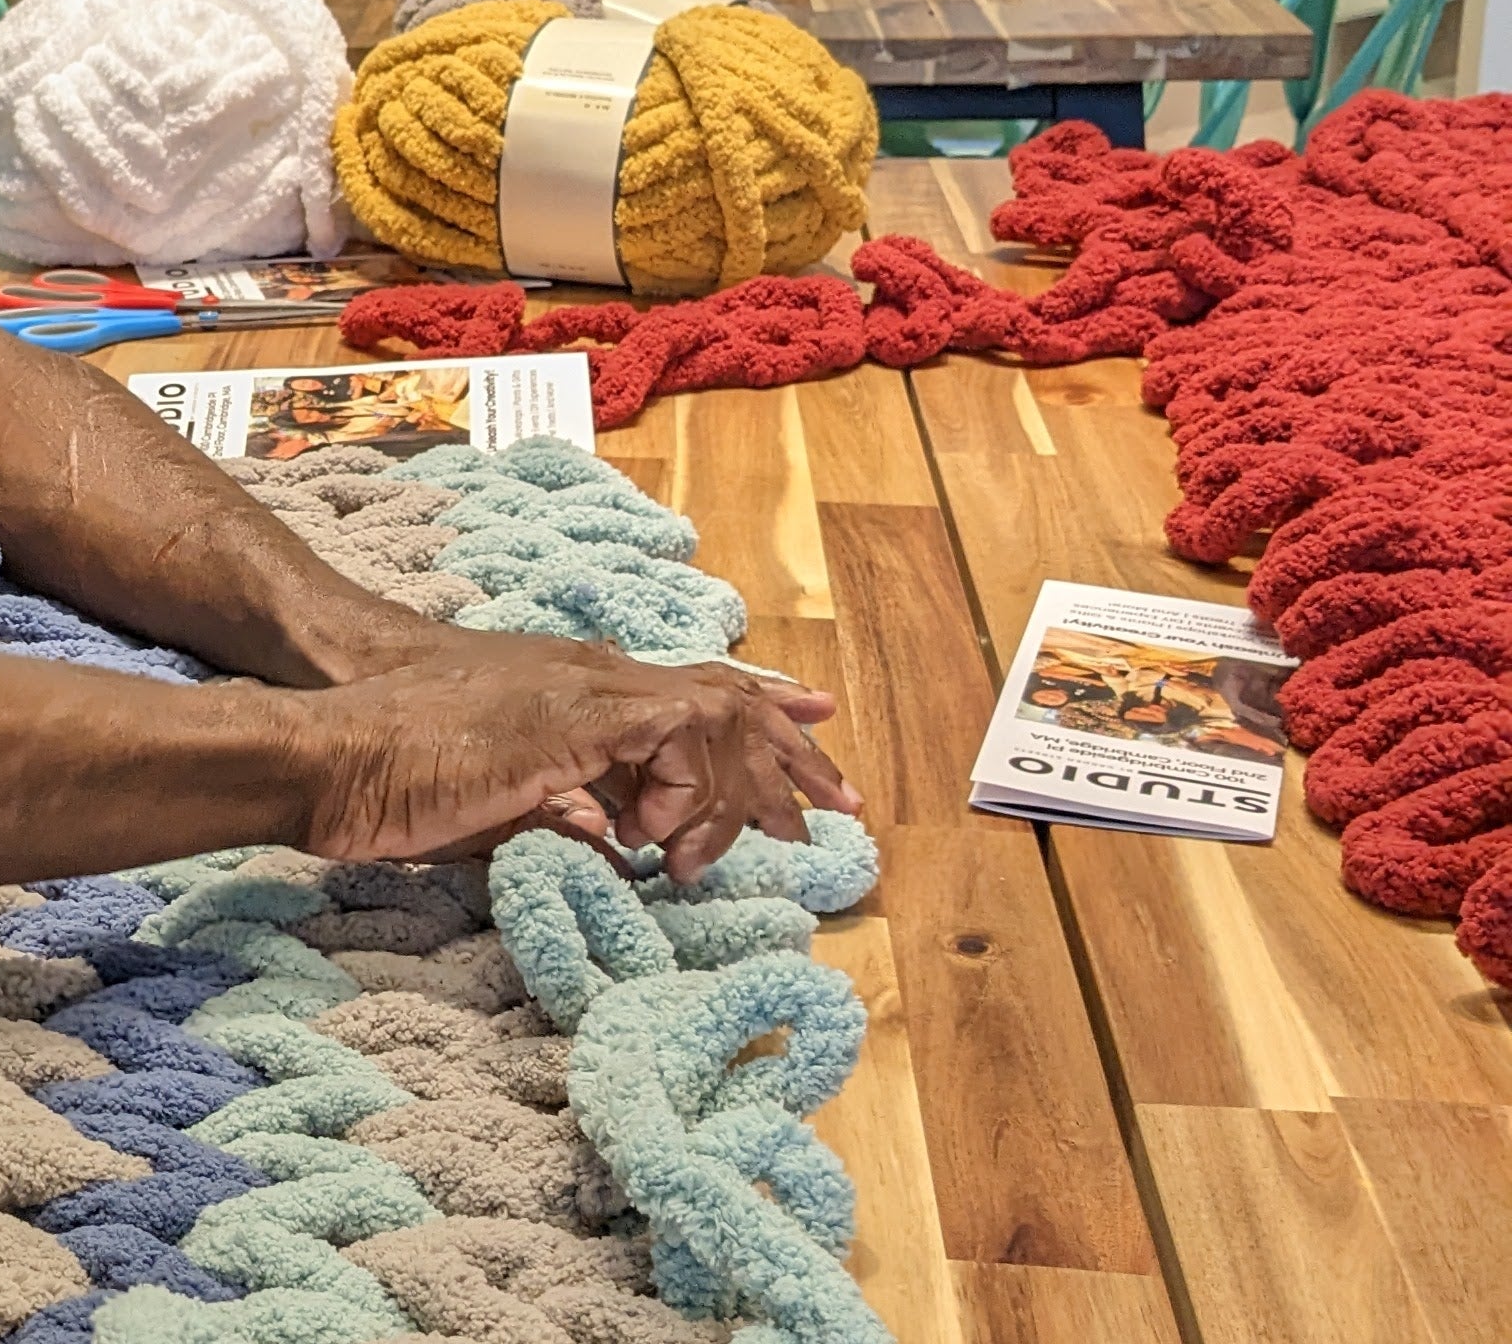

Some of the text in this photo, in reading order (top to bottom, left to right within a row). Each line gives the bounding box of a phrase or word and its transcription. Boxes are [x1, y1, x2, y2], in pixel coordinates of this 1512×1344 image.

[1063, 618, 1160, 638] Creativity!
[1164, 634, 1207, 646] Your
[1031, 732, 1267, 781] 2nd Floor, Cambridge, MA
[1069, 748, 1210, 778] Cambridgeside
[1009, 757, 1269, 814] STUDIO
[1215, 773, 1245, 784] 100
